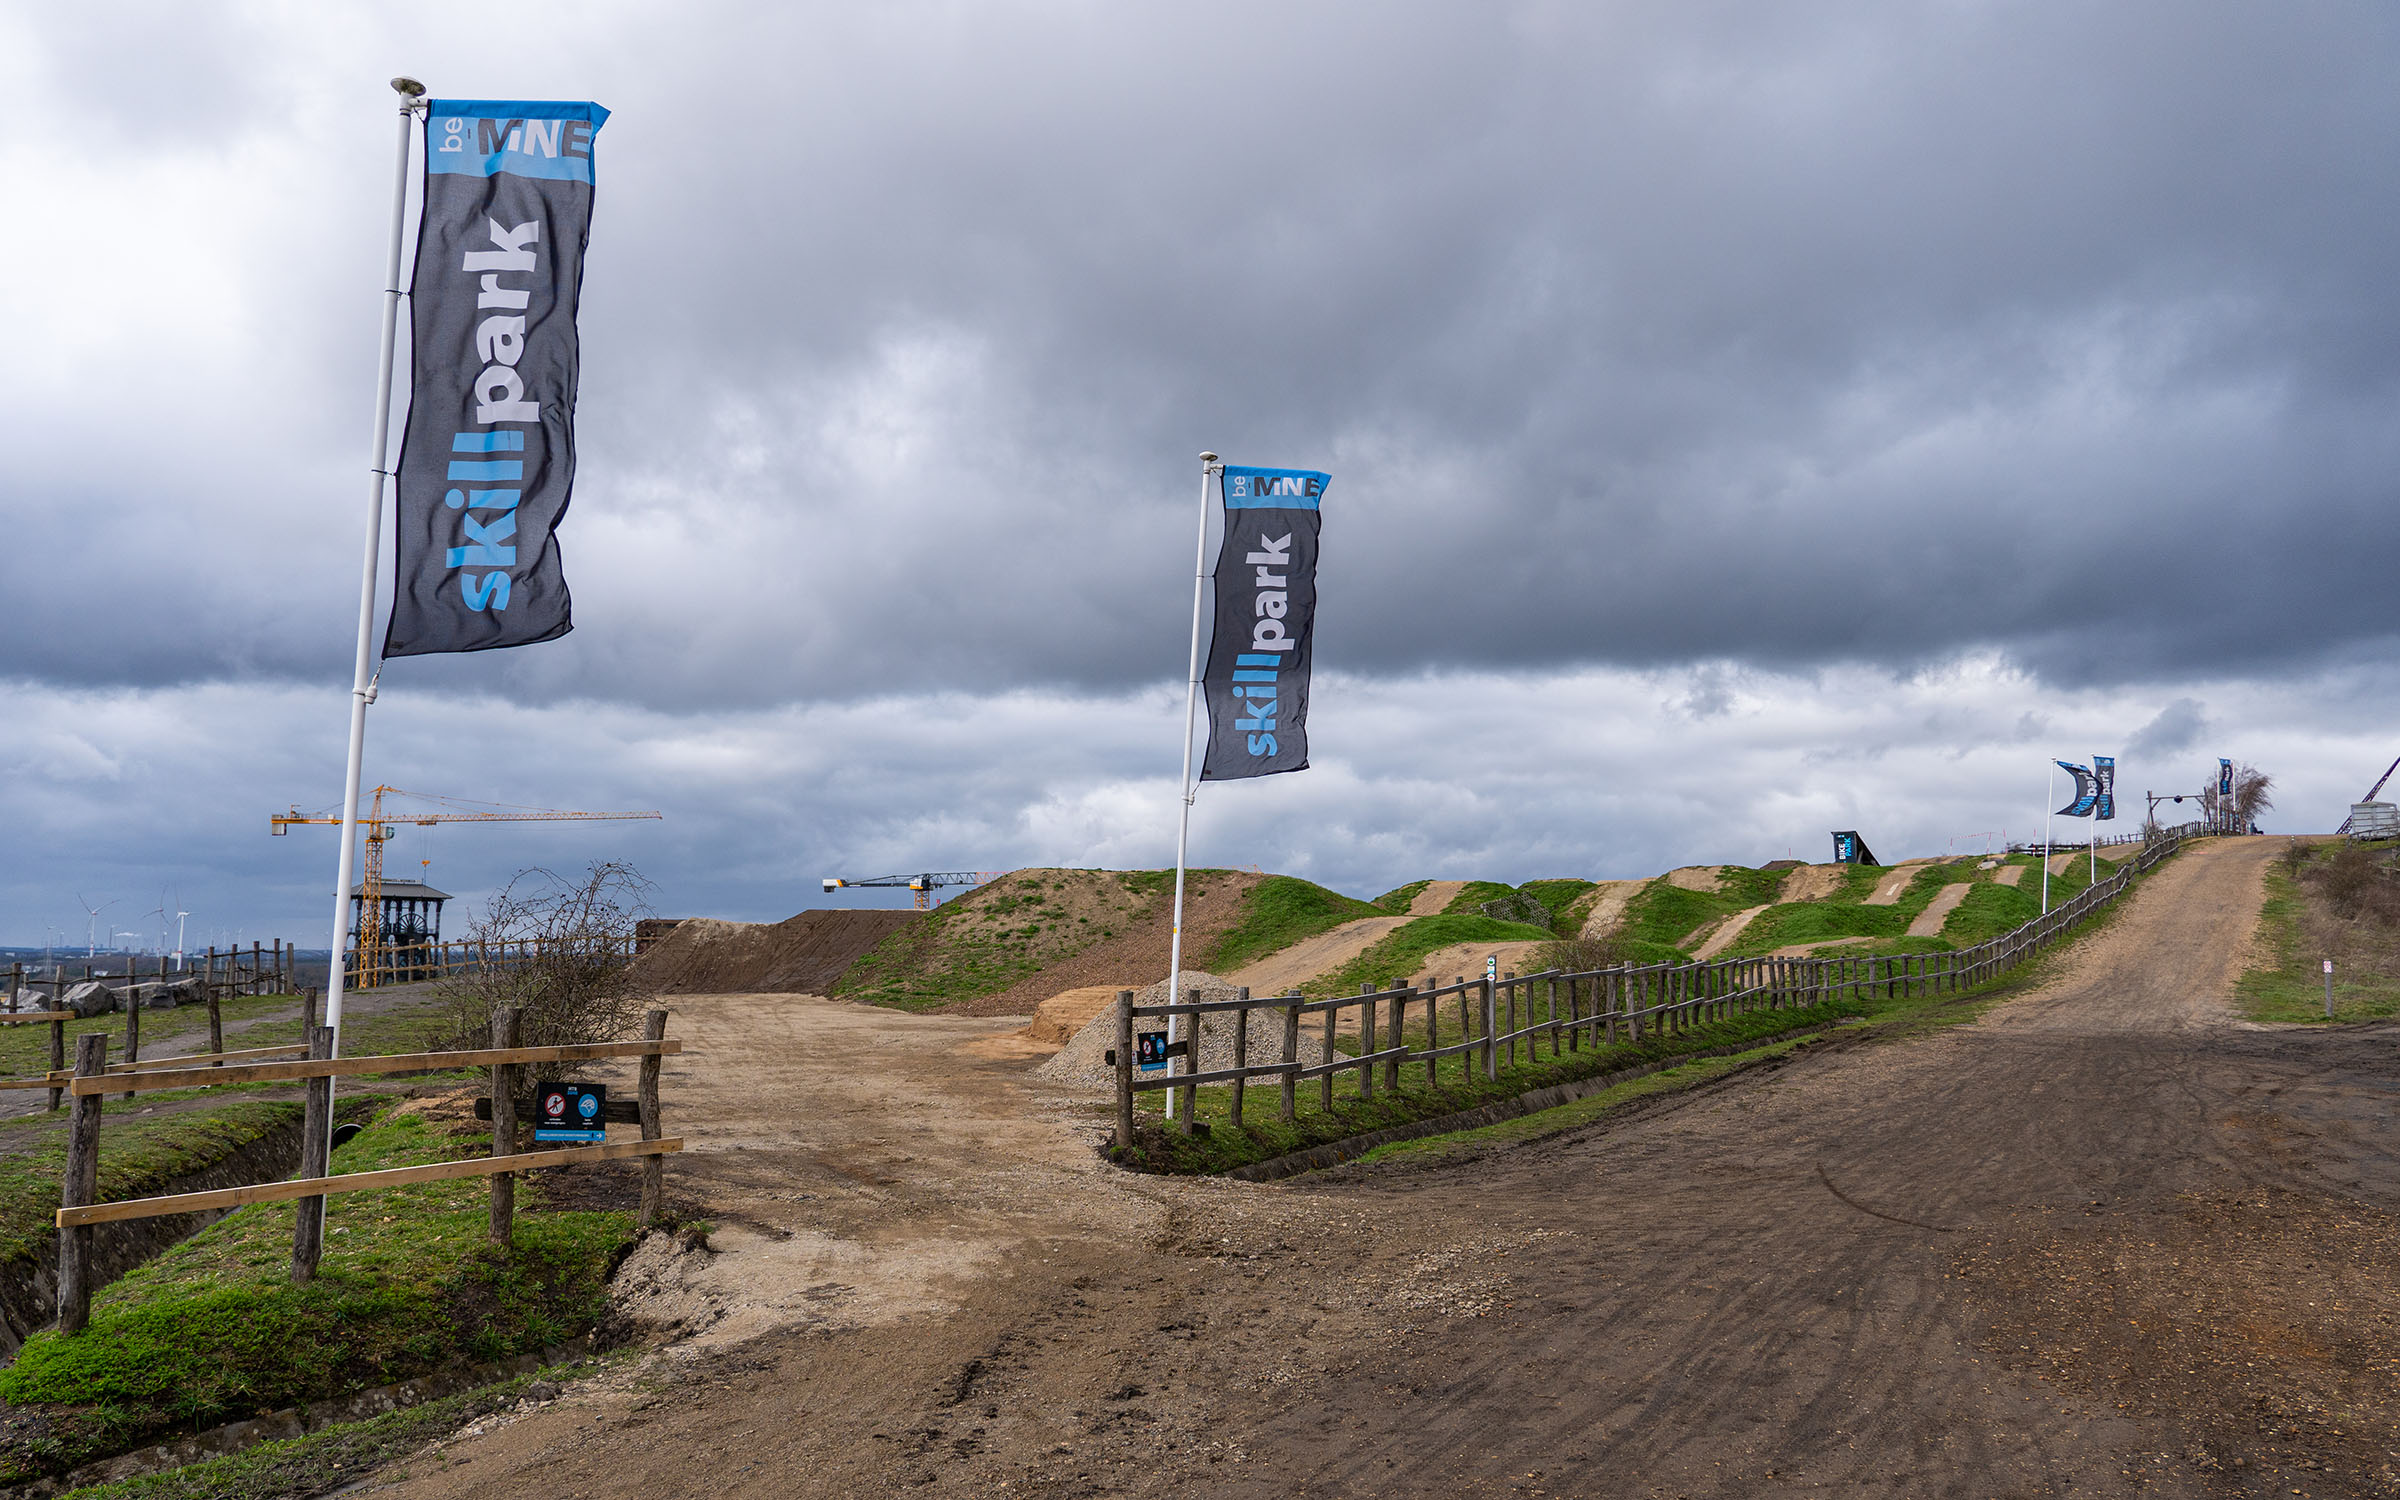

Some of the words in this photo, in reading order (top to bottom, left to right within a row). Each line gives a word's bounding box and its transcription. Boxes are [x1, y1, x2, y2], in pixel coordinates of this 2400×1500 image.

[439, 117, 463, 152] be
[445, 217, 541, 613] skillpark
[1232, 475, 1246, 496] be
[1232, 532, 1295, 757] skillpark
[1838, 843, 1846, 860] BIKE
[1844, 837, 1852, 857] PARK
